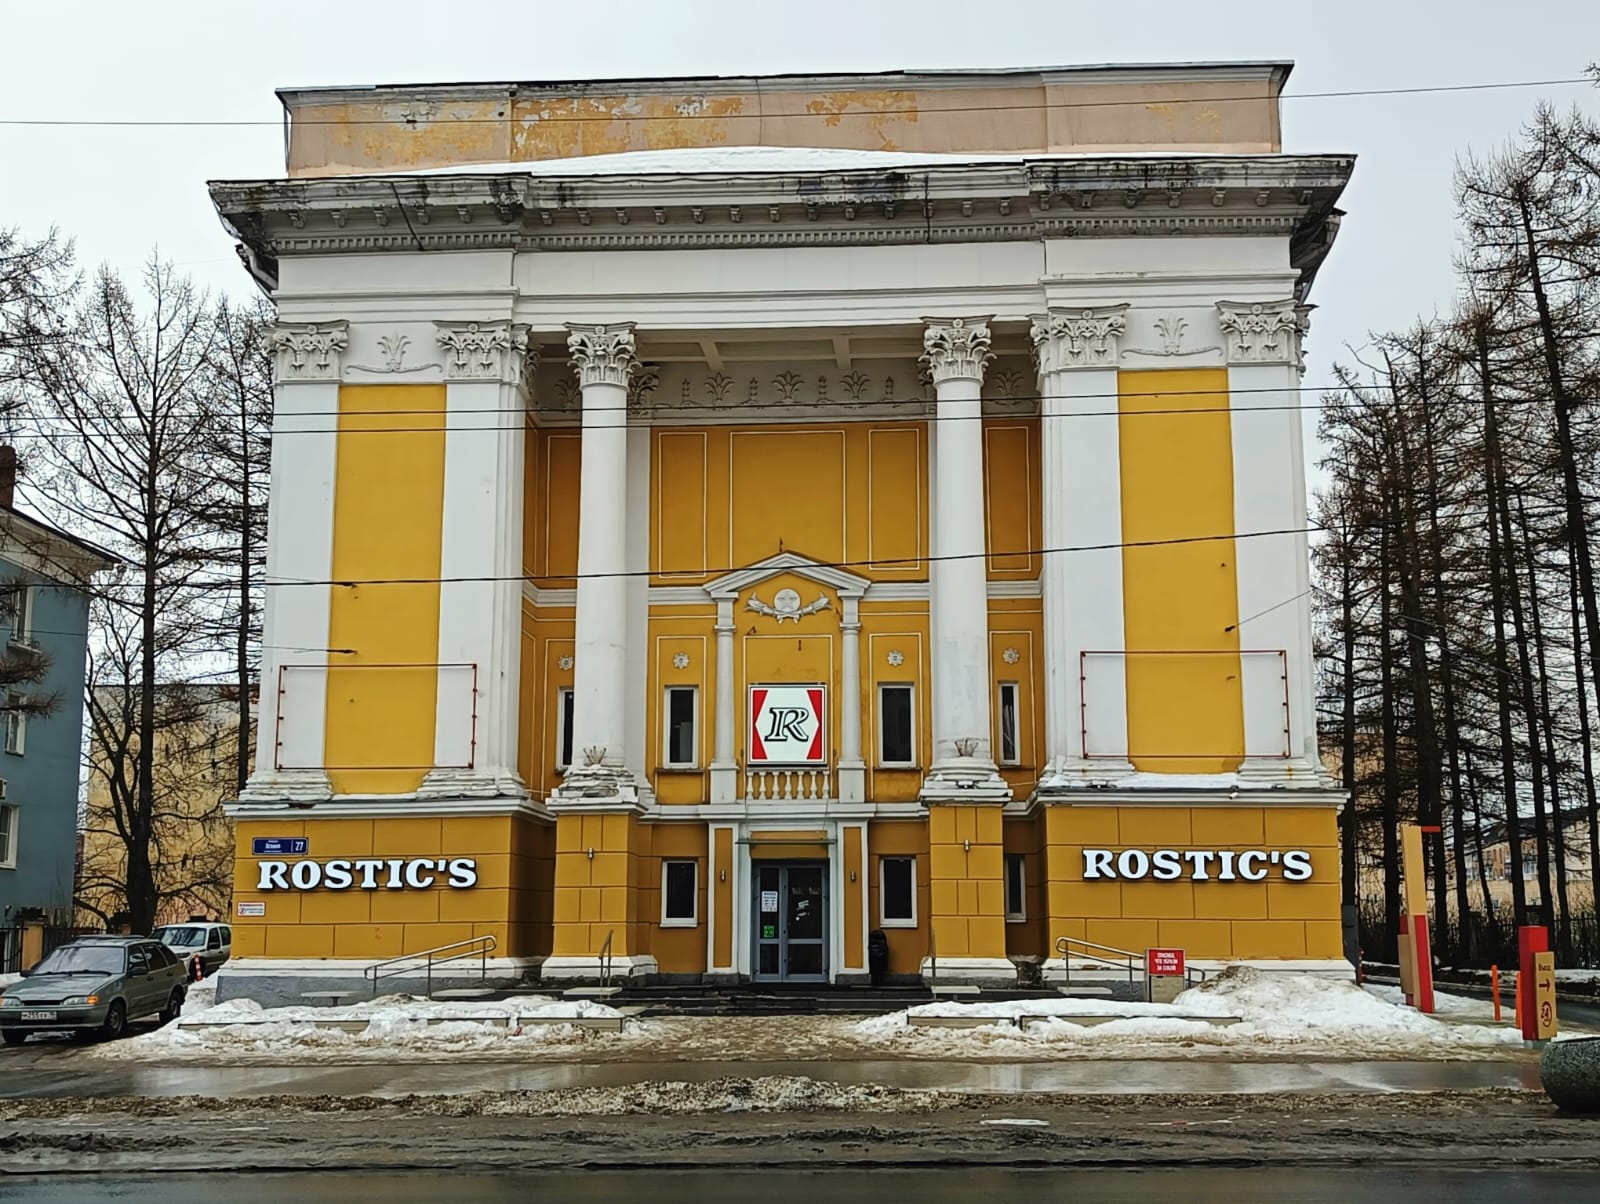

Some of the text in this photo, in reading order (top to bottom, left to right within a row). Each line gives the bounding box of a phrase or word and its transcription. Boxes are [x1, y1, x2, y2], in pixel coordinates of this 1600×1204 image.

[764, 706, 810, 743] R
[257, 858, 478, 890] ROSTIC'S
[1082, 848, 1314, 881] ROSTIC'S
